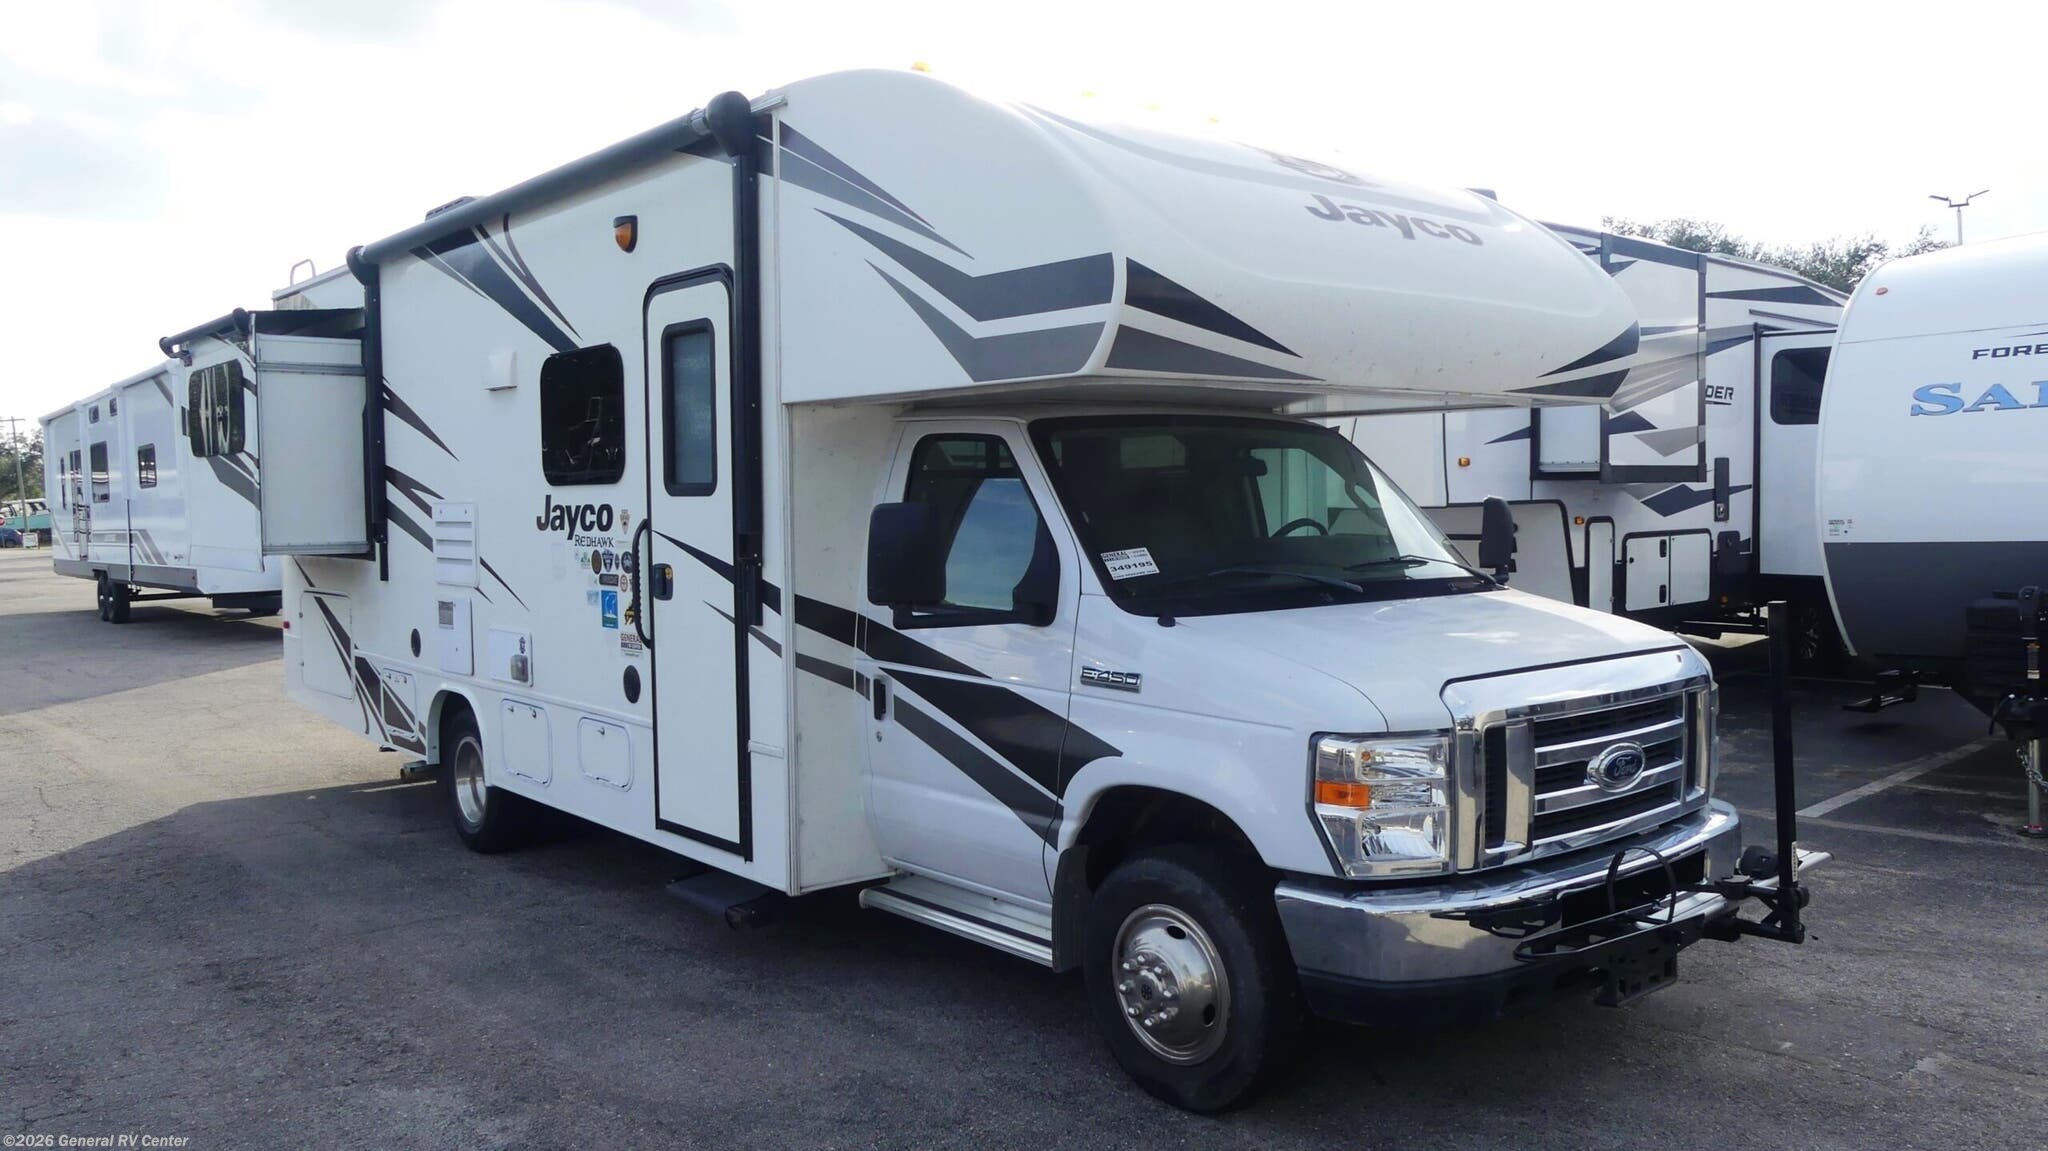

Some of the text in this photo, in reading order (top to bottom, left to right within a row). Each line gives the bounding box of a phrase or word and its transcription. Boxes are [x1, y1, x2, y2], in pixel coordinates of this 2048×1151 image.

[1304, 194, 1484, 246] Jayco
[1972, 343, 2048, 360] FORE
[536, 494, 613, 540] Jayco
[574, 534, 614, 547] REDHAWK
[1110, 560, 1153, 572] 349195
[1614, 756, 1638, 776] Ford
